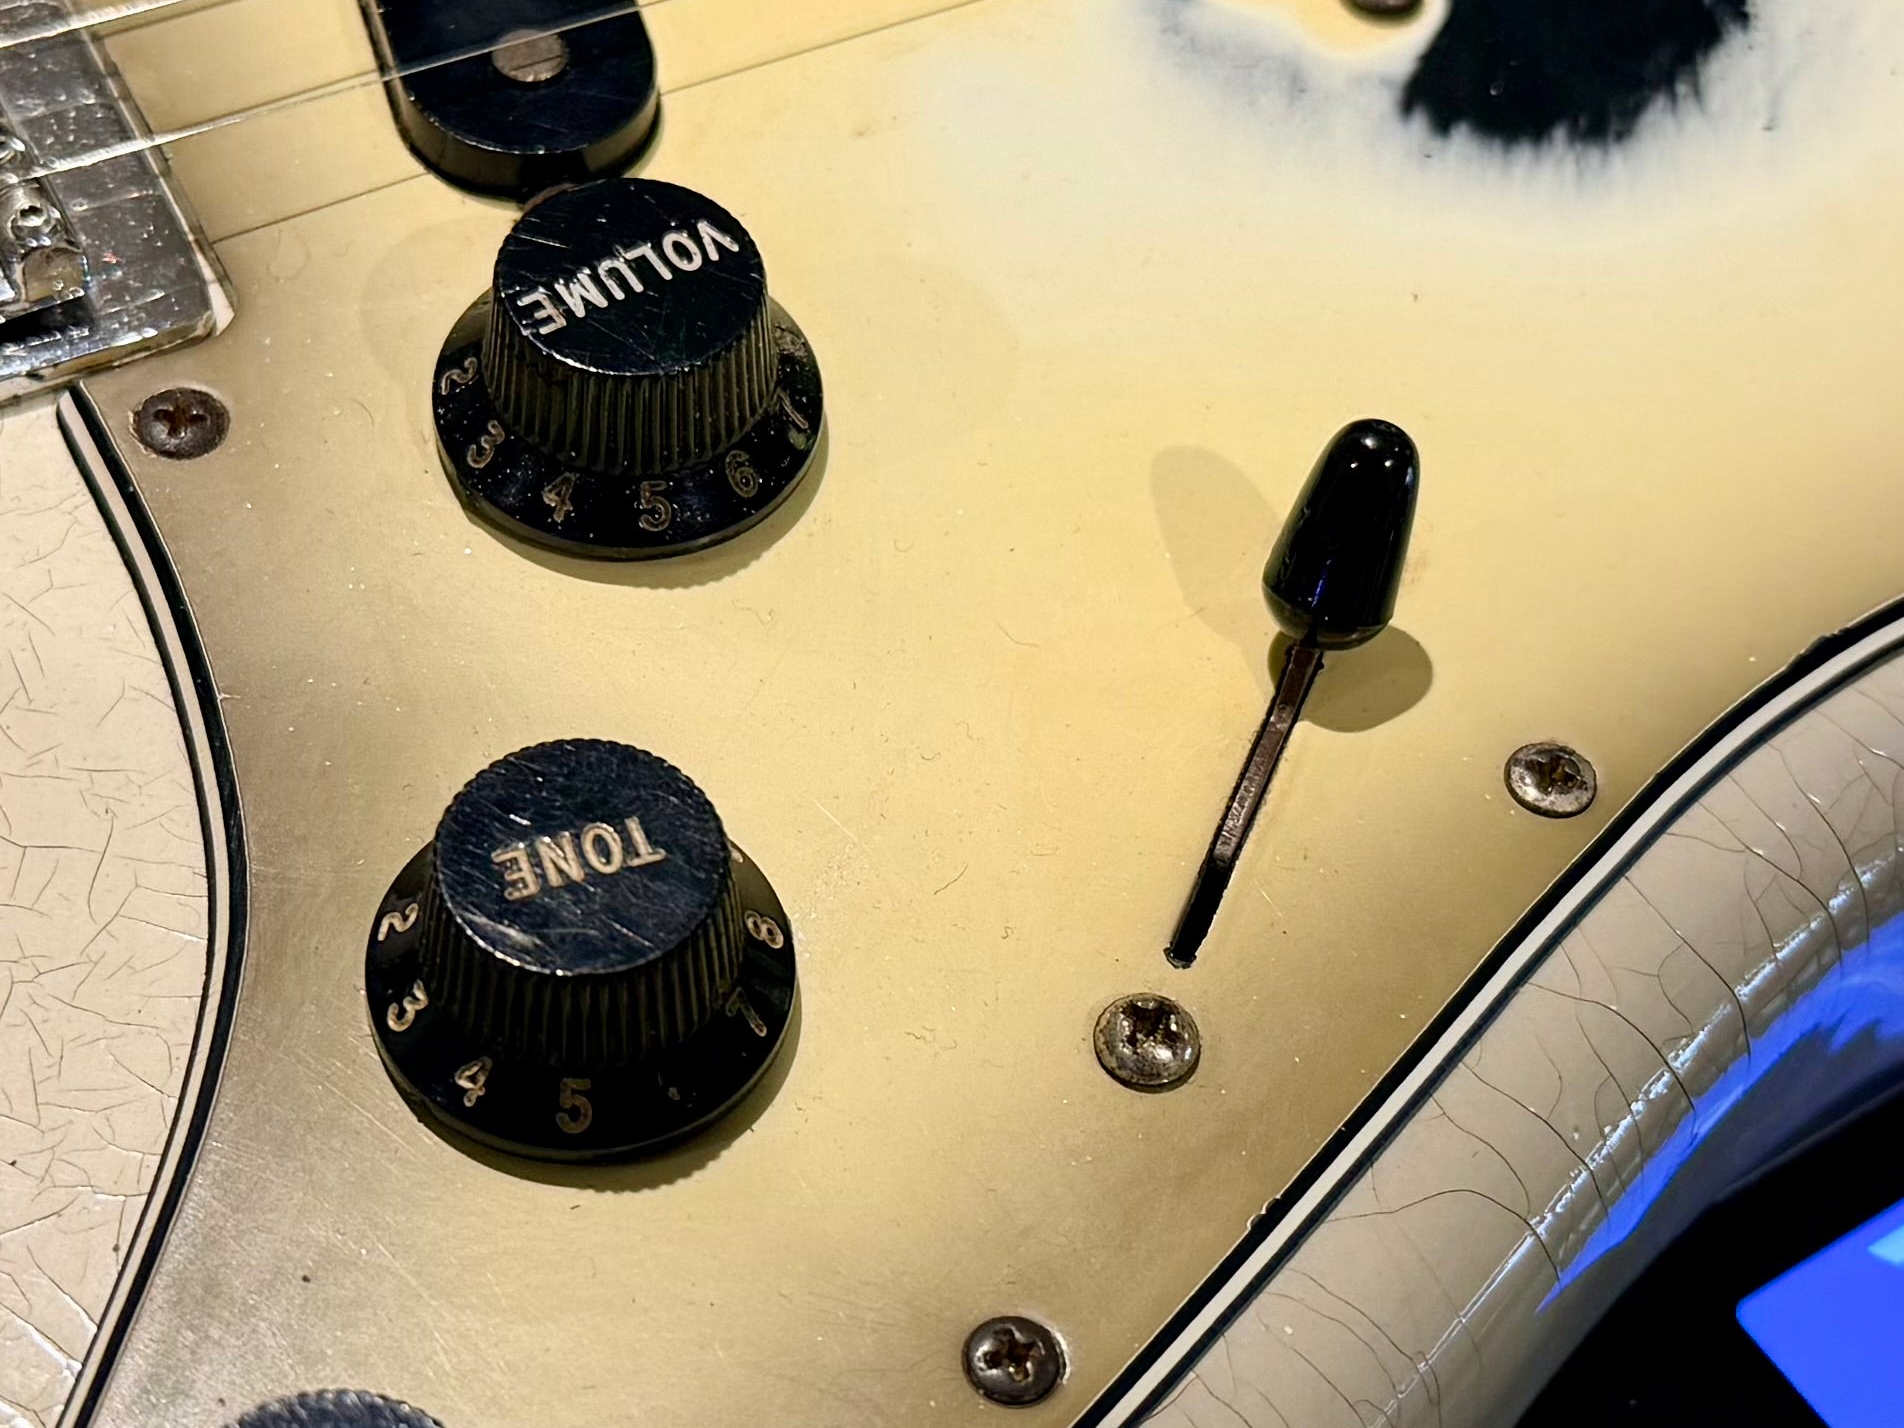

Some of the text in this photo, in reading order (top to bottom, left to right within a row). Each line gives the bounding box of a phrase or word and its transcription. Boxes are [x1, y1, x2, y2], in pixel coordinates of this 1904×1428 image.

[516, 219, 739, 335] VOLUME
[441, 357, 478, 395] 2
[467, 420, 505, 468] 3
[542, 473, 576, 522] 4
[639, 481, 672, 531] 5
[725, 450, 759, 499] 6
[491, 816, 667, 901] TONE
[378, 903, 419, 942] 2
[744, 909, 785, 950] 8
[386, 979, 429, 1032] 3
[454, 1056, 493, 1108] 4
[556, 1077, 593, 1134] 5
